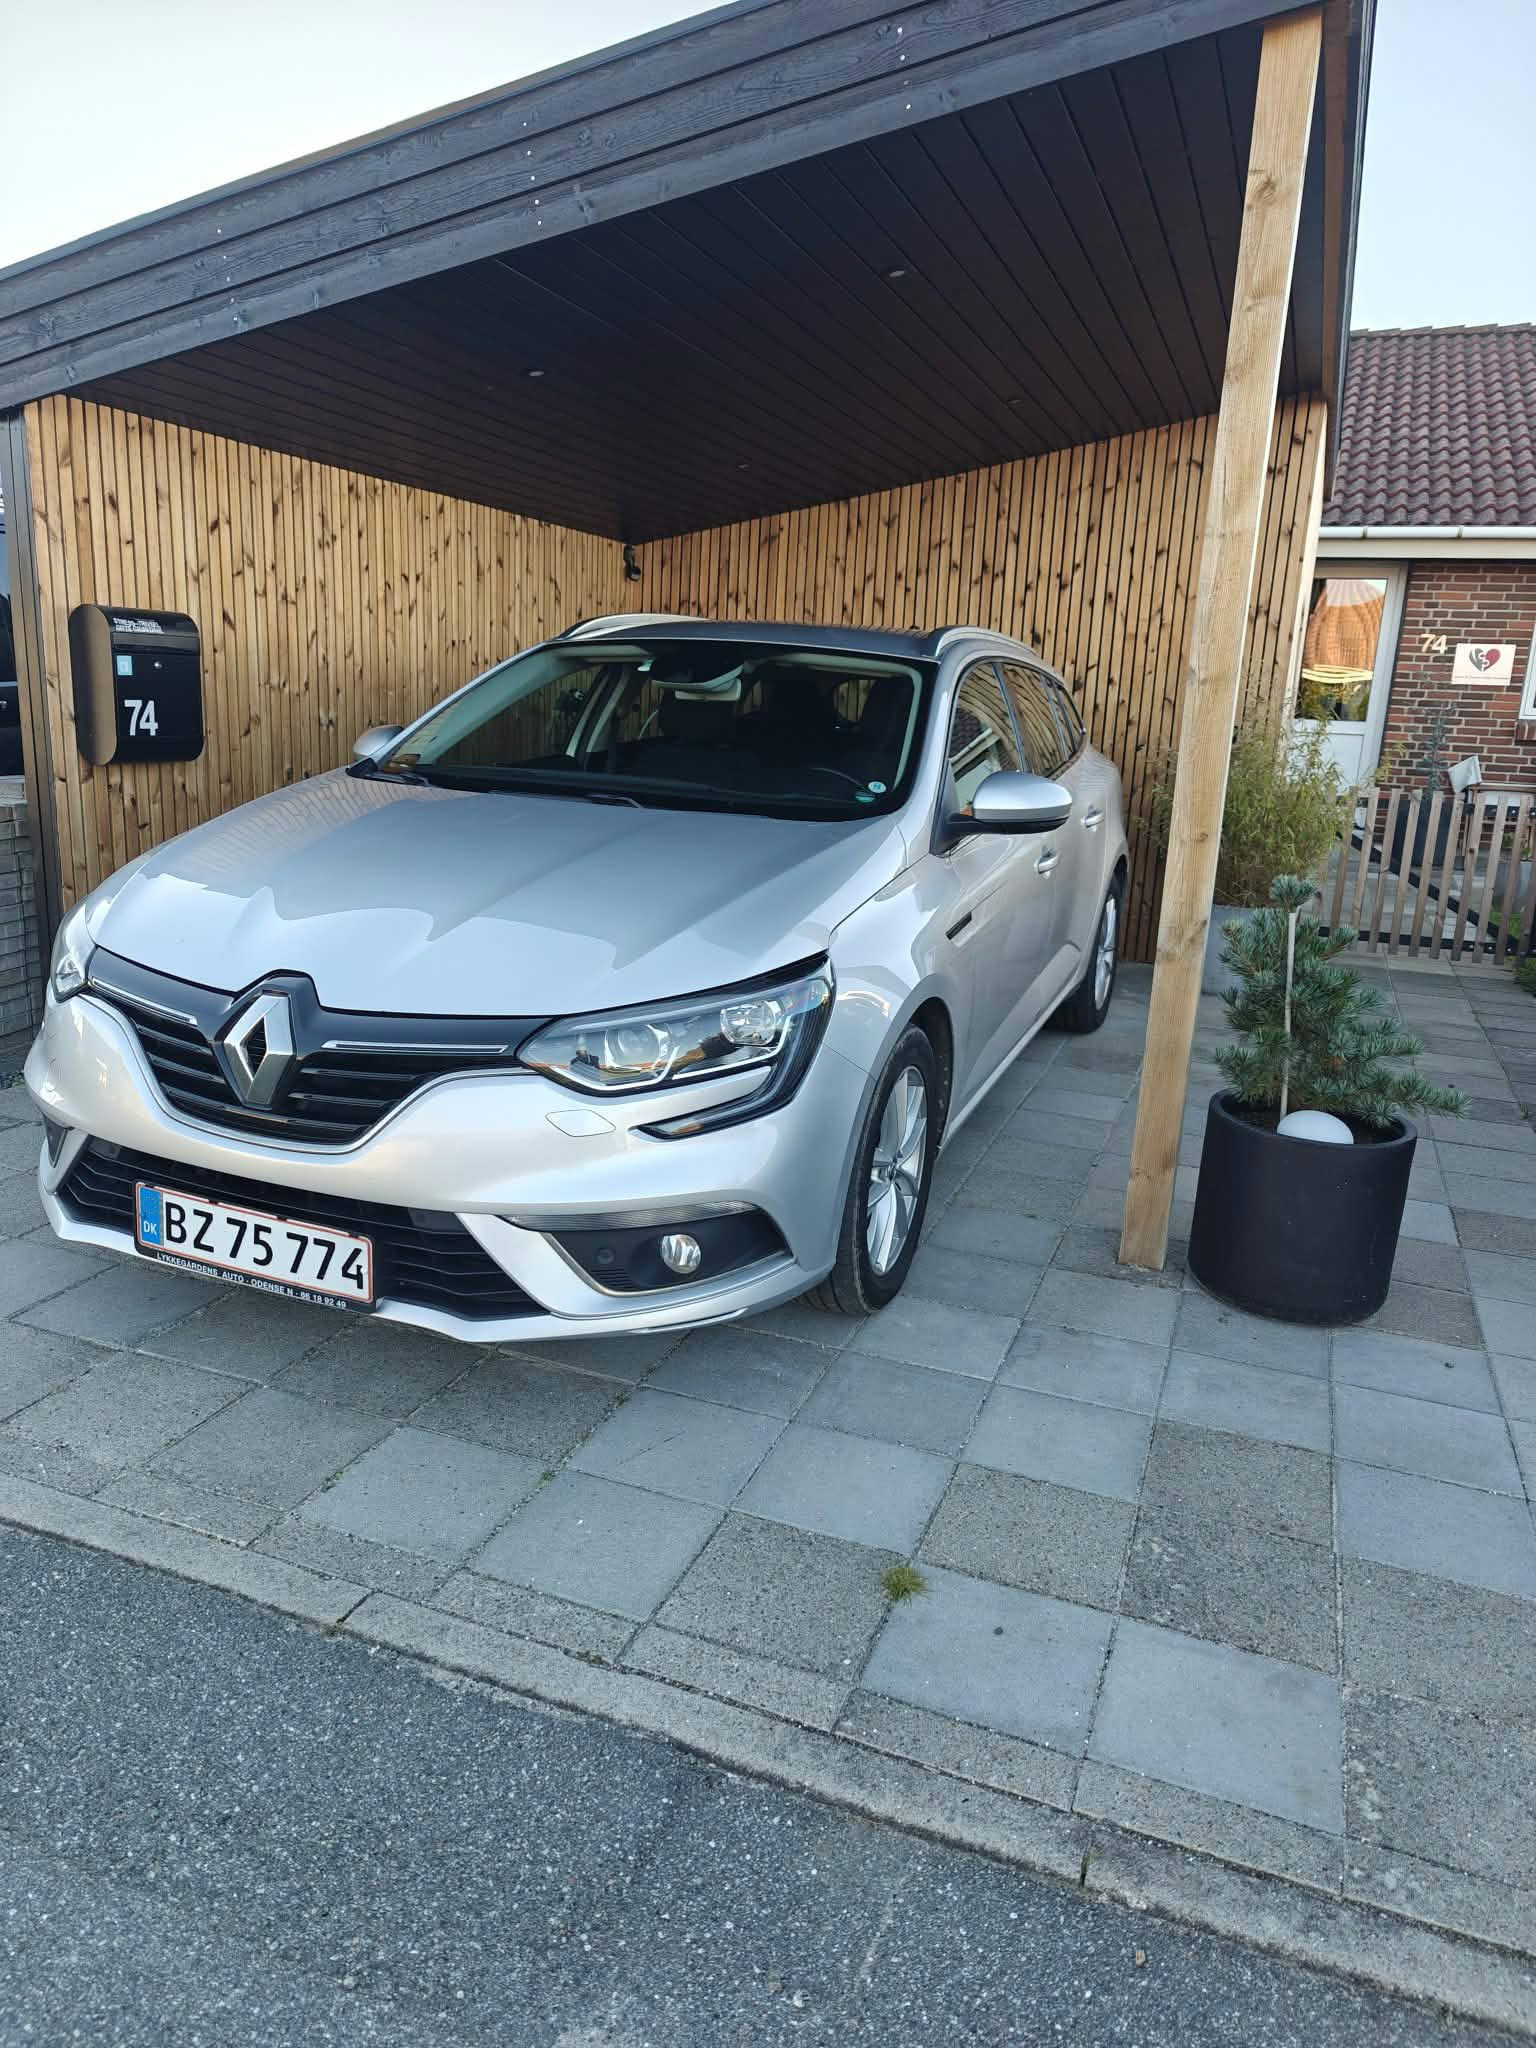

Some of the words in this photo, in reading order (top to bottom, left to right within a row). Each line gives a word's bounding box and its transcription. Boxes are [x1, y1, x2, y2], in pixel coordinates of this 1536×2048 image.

[1420, 633, 1448, 654] 74
[124, 699, 158, 736] 74
[143, 1220, 158, 1236] DK
[165, 1201, 214, 1253] BZ
[226, 1216, 273, 1266] 75
[286, 1231, 364, 1290] 774
[222, 1271, 244, 1284] AUTO
[250, 1278, 286, 1293] ODENSE
